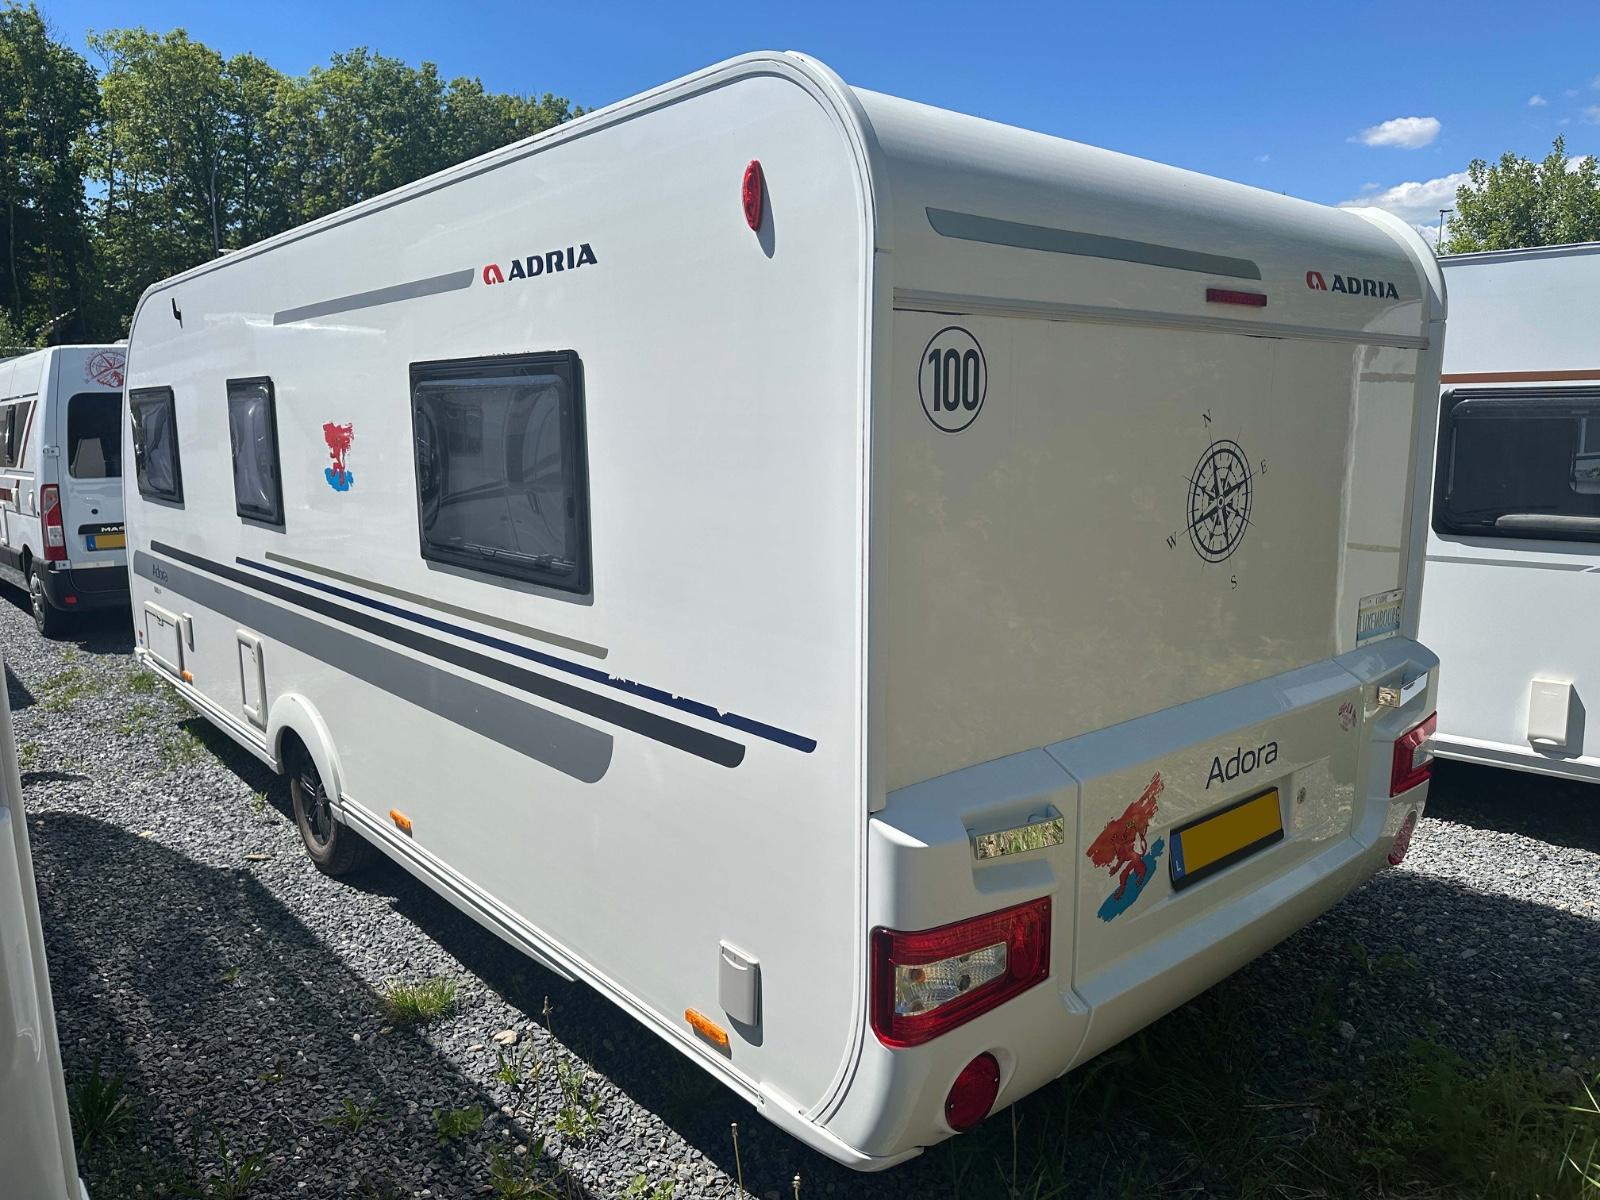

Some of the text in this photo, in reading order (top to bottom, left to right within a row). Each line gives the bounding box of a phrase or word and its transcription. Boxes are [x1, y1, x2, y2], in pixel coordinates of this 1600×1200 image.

[508, 243, 598, 281] ADRIA
[1331, 274, 1400, 300] ADRIA
[928, 348, 980, 411] 100
[1202, 409, 1213, 428] N
[1260, 459, 1272, 475] E
[1166, 532, 1179, 550] W
[1230, 575, 1238, 590] S
[1205, 741, 1278, 790] Adora
[1175, 860, 1182, 871] L
